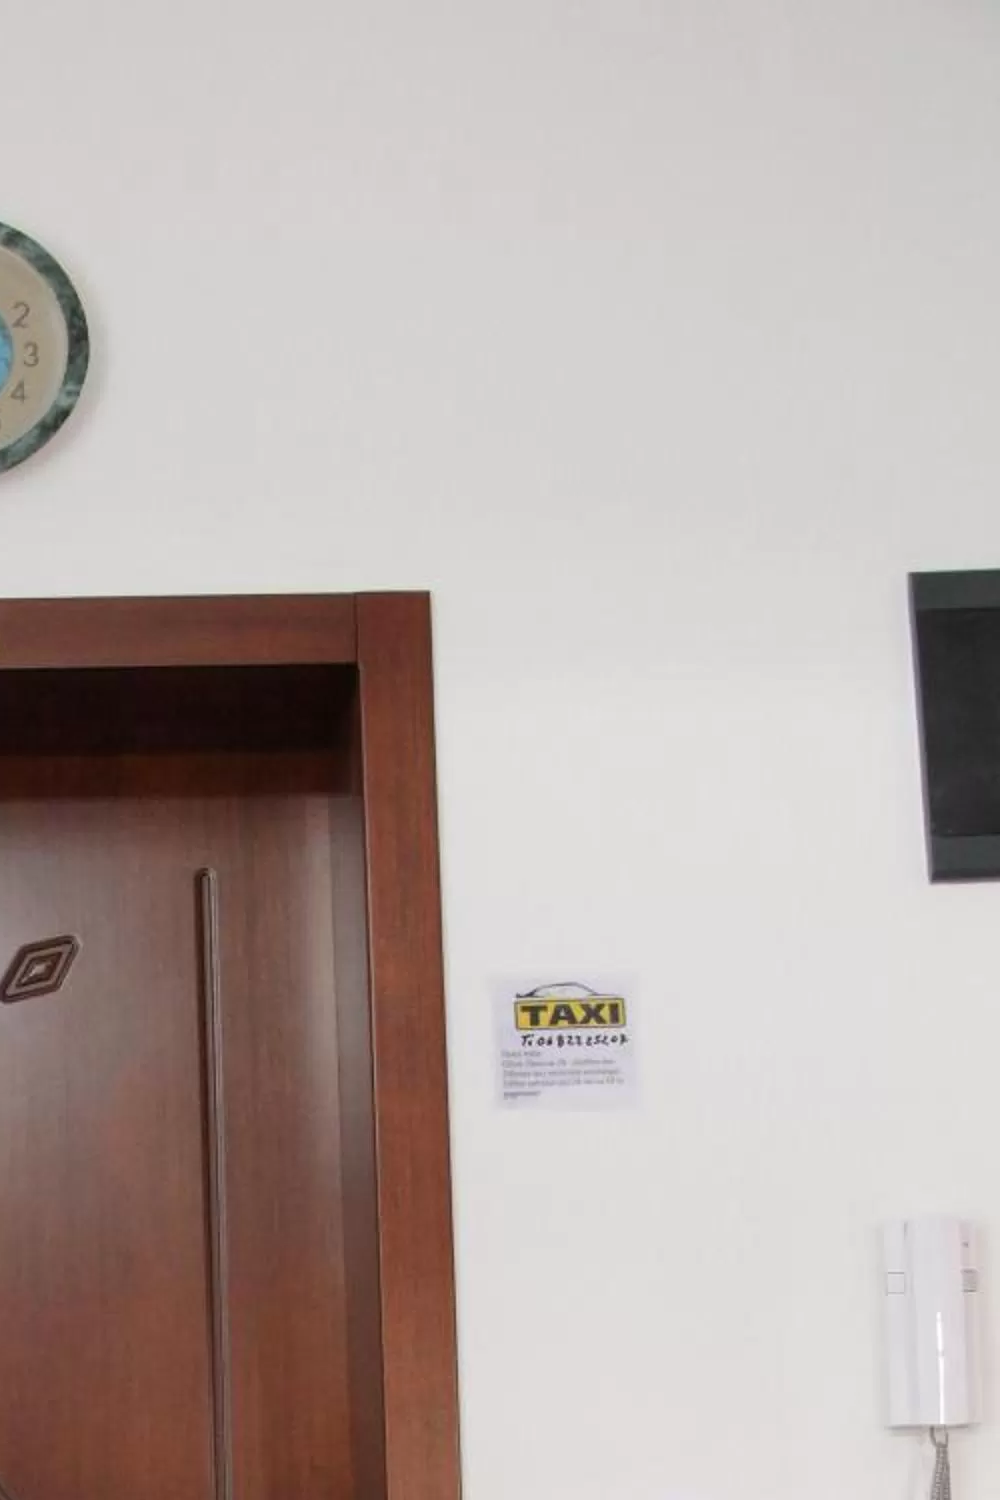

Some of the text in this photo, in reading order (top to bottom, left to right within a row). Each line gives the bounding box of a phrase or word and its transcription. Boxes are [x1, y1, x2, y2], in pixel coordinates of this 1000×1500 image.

[11, 302, 30, 328] 2
[23, 342, 39, 367] 3
[11, 380, 27, 403] 4
[520, 1003, 620, 1026] TAXI
